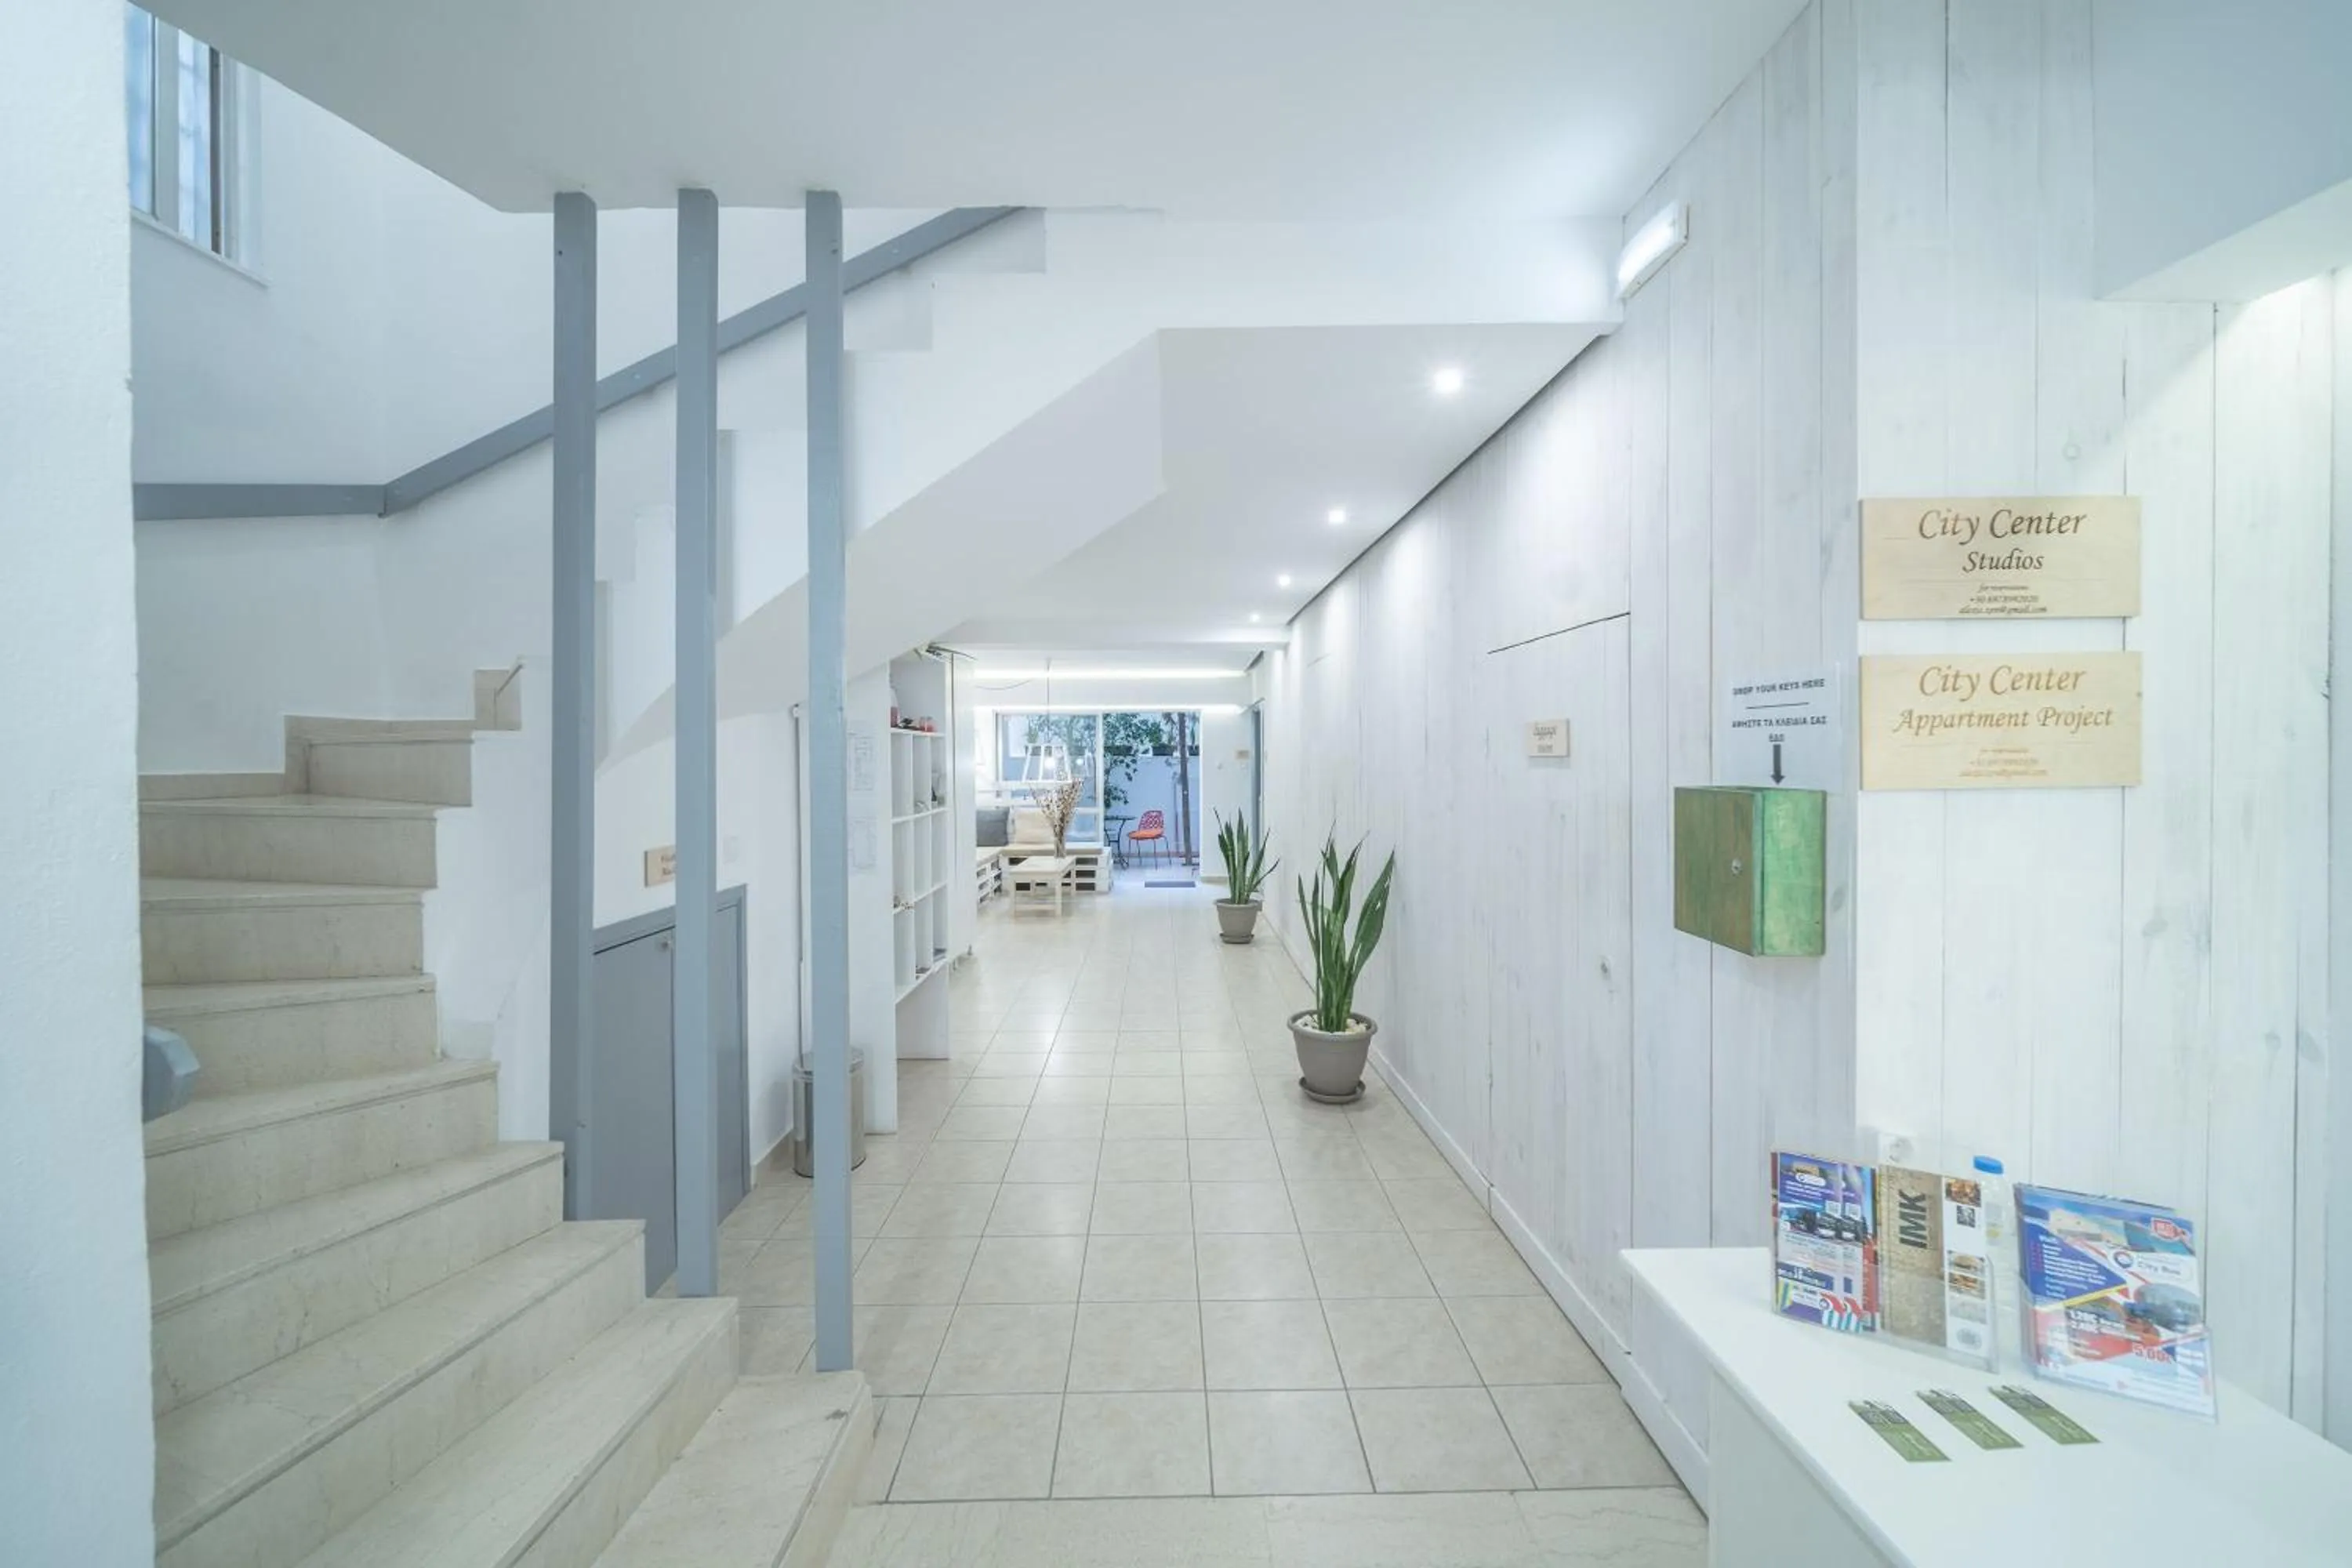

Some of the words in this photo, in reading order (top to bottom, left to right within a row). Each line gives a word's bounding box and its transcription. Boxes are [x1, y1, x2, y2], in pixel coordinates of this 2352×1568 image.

[1918, 507, 1980, 545] City
[1989, 509, 2087, 539] Center
[1962, 548, 2045, 573] Studios
[1733, 687, 1753, 696] DROP
[1756, 684, 1777, 694] YOUR
[1779, 681, 1799, 691] KEYS
[1802, 678, 1825, 688] HERE
[1919, 665, 1980, 702] City
[1990, 665, 2087, 695] Center
[1893, 708, 2030, 736] Appartment
[2037, 706, 2114, 735] Project
